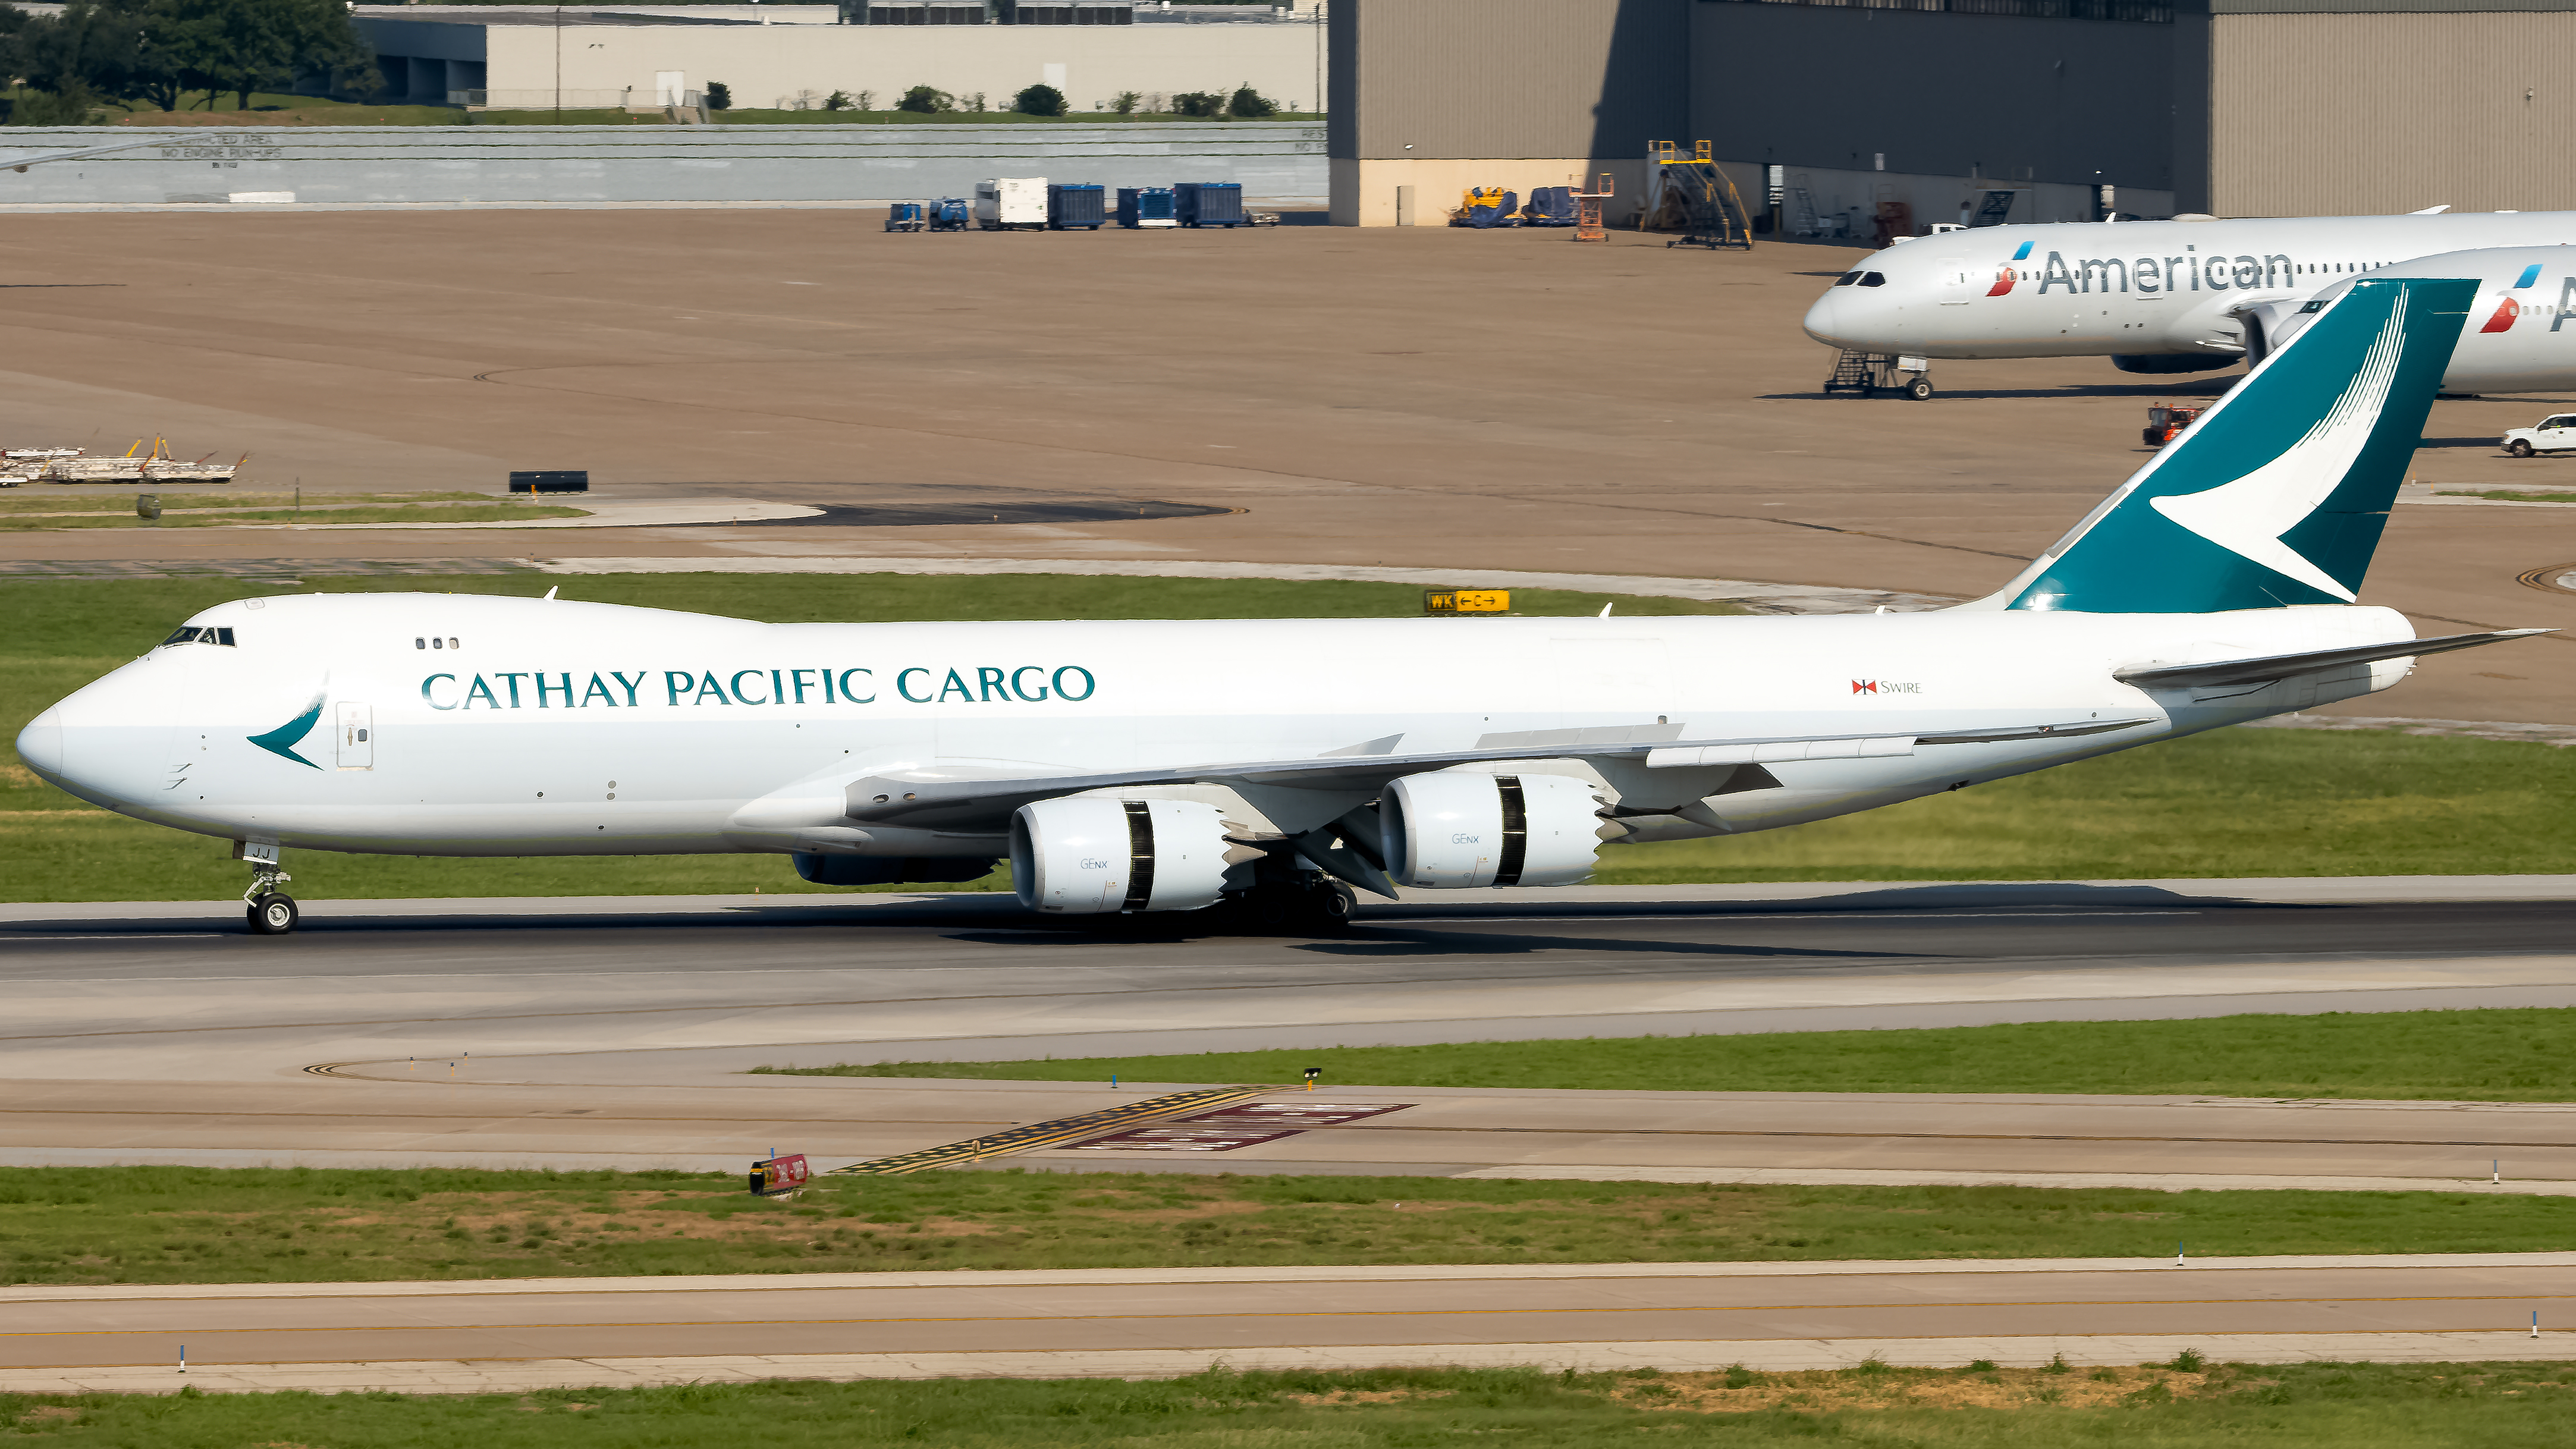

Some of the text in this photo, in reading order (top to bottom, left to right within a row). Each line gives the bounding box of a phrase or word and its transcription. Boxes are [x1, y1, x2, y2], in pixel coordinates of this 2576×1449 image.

[161, 149, 178, 158] NO
[2038, 244, 2294, 294] American
[2549, 276, 2576, 332] A
[1431, 595, 1453, 608] WK
[422, 666, 1095, 710] CATHAY PACIFIC CARGO
[252, 847, 270, 859] JJ
